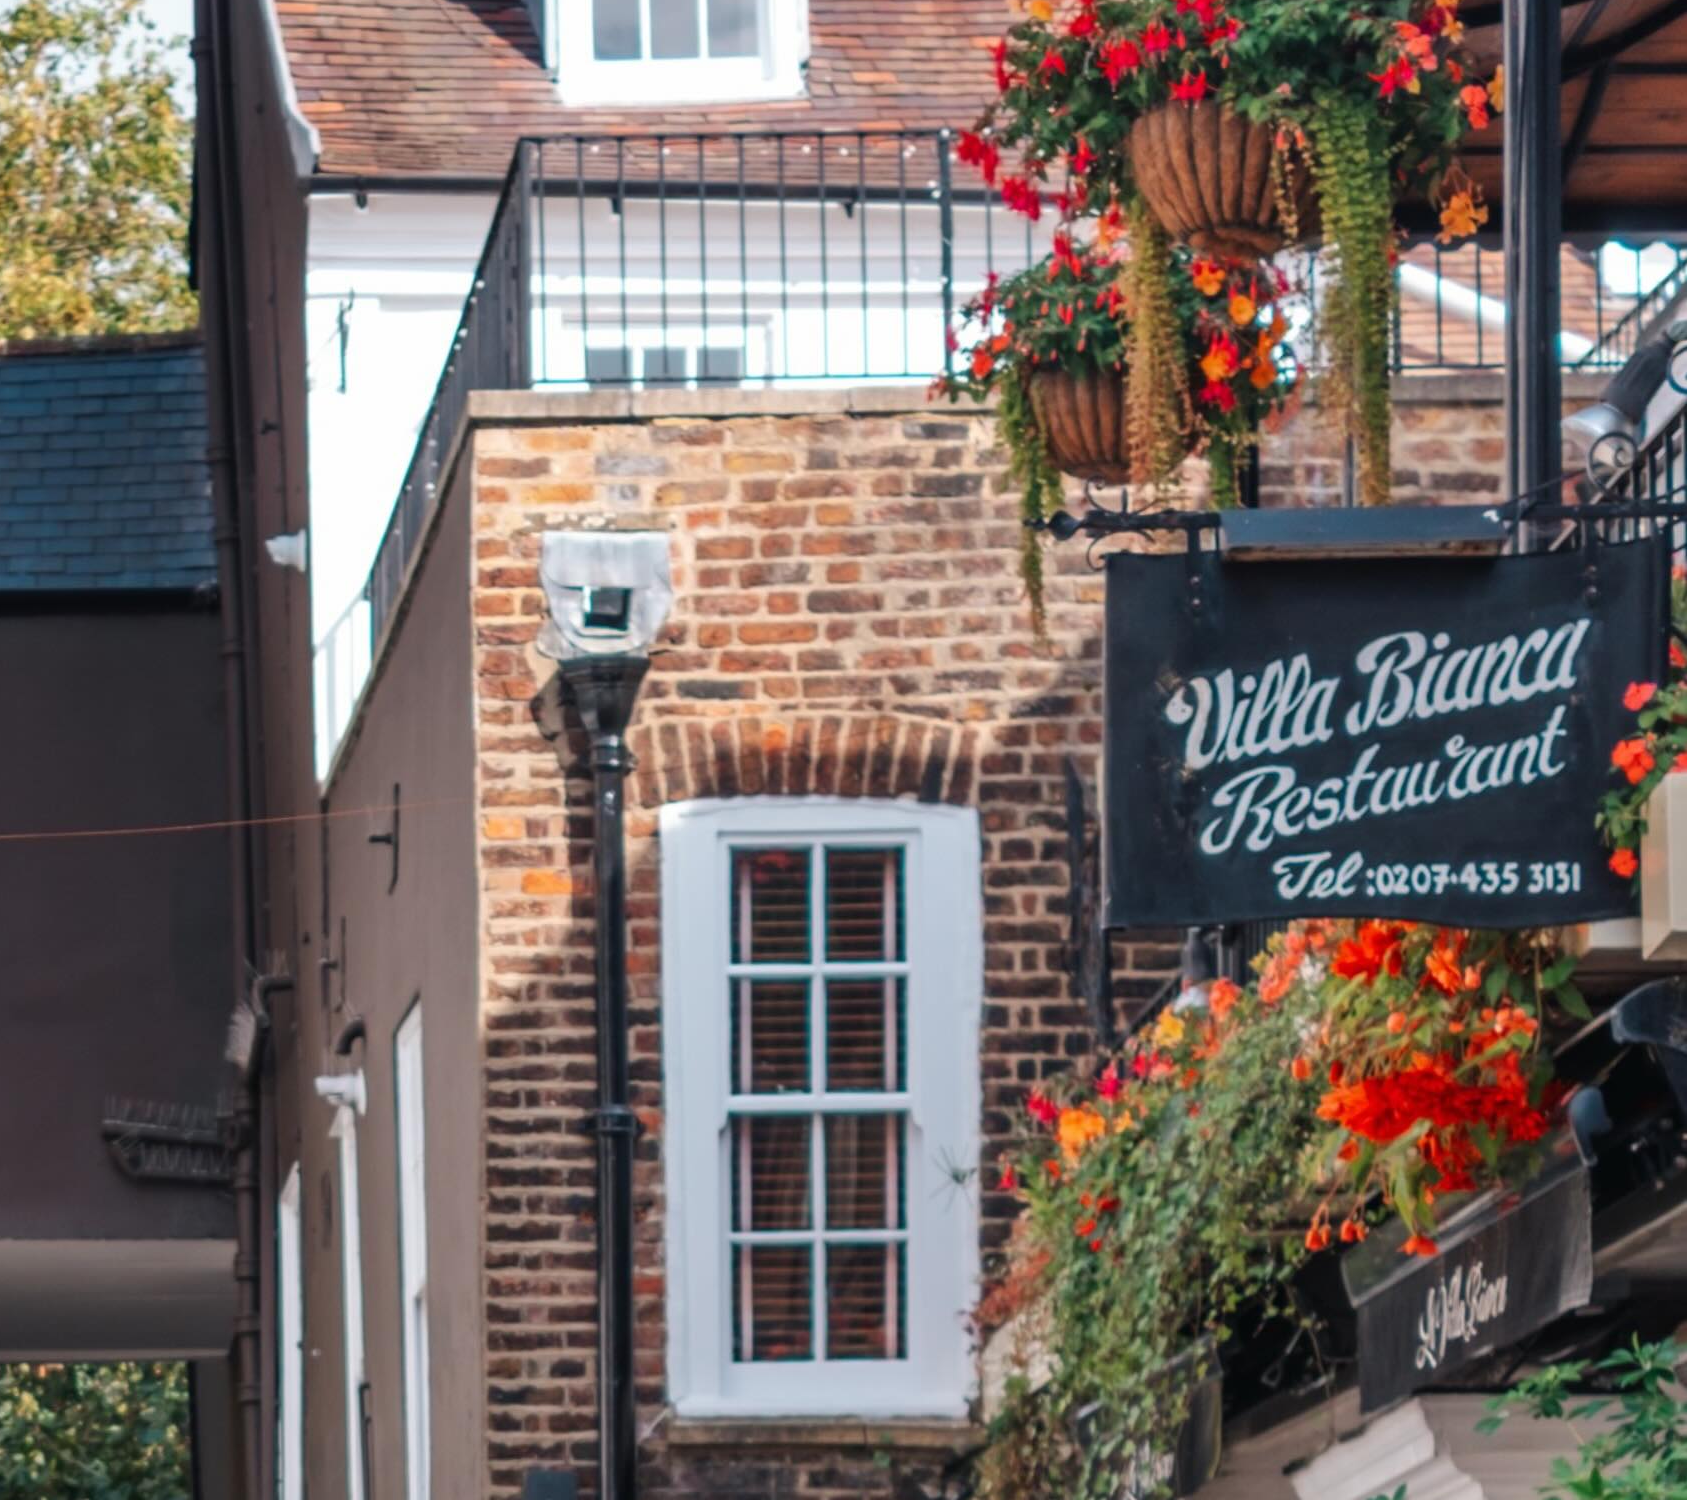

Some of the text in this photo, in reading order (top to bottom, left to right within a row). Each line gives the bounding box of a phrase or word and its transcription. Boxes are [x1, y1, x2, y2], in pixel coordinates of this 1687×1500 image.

[1165, 618, 1591, 770] Villa Bianca
[1200, 705, 1567, 854] Restaurant
[1527, 861, 1581, 894] 3131
